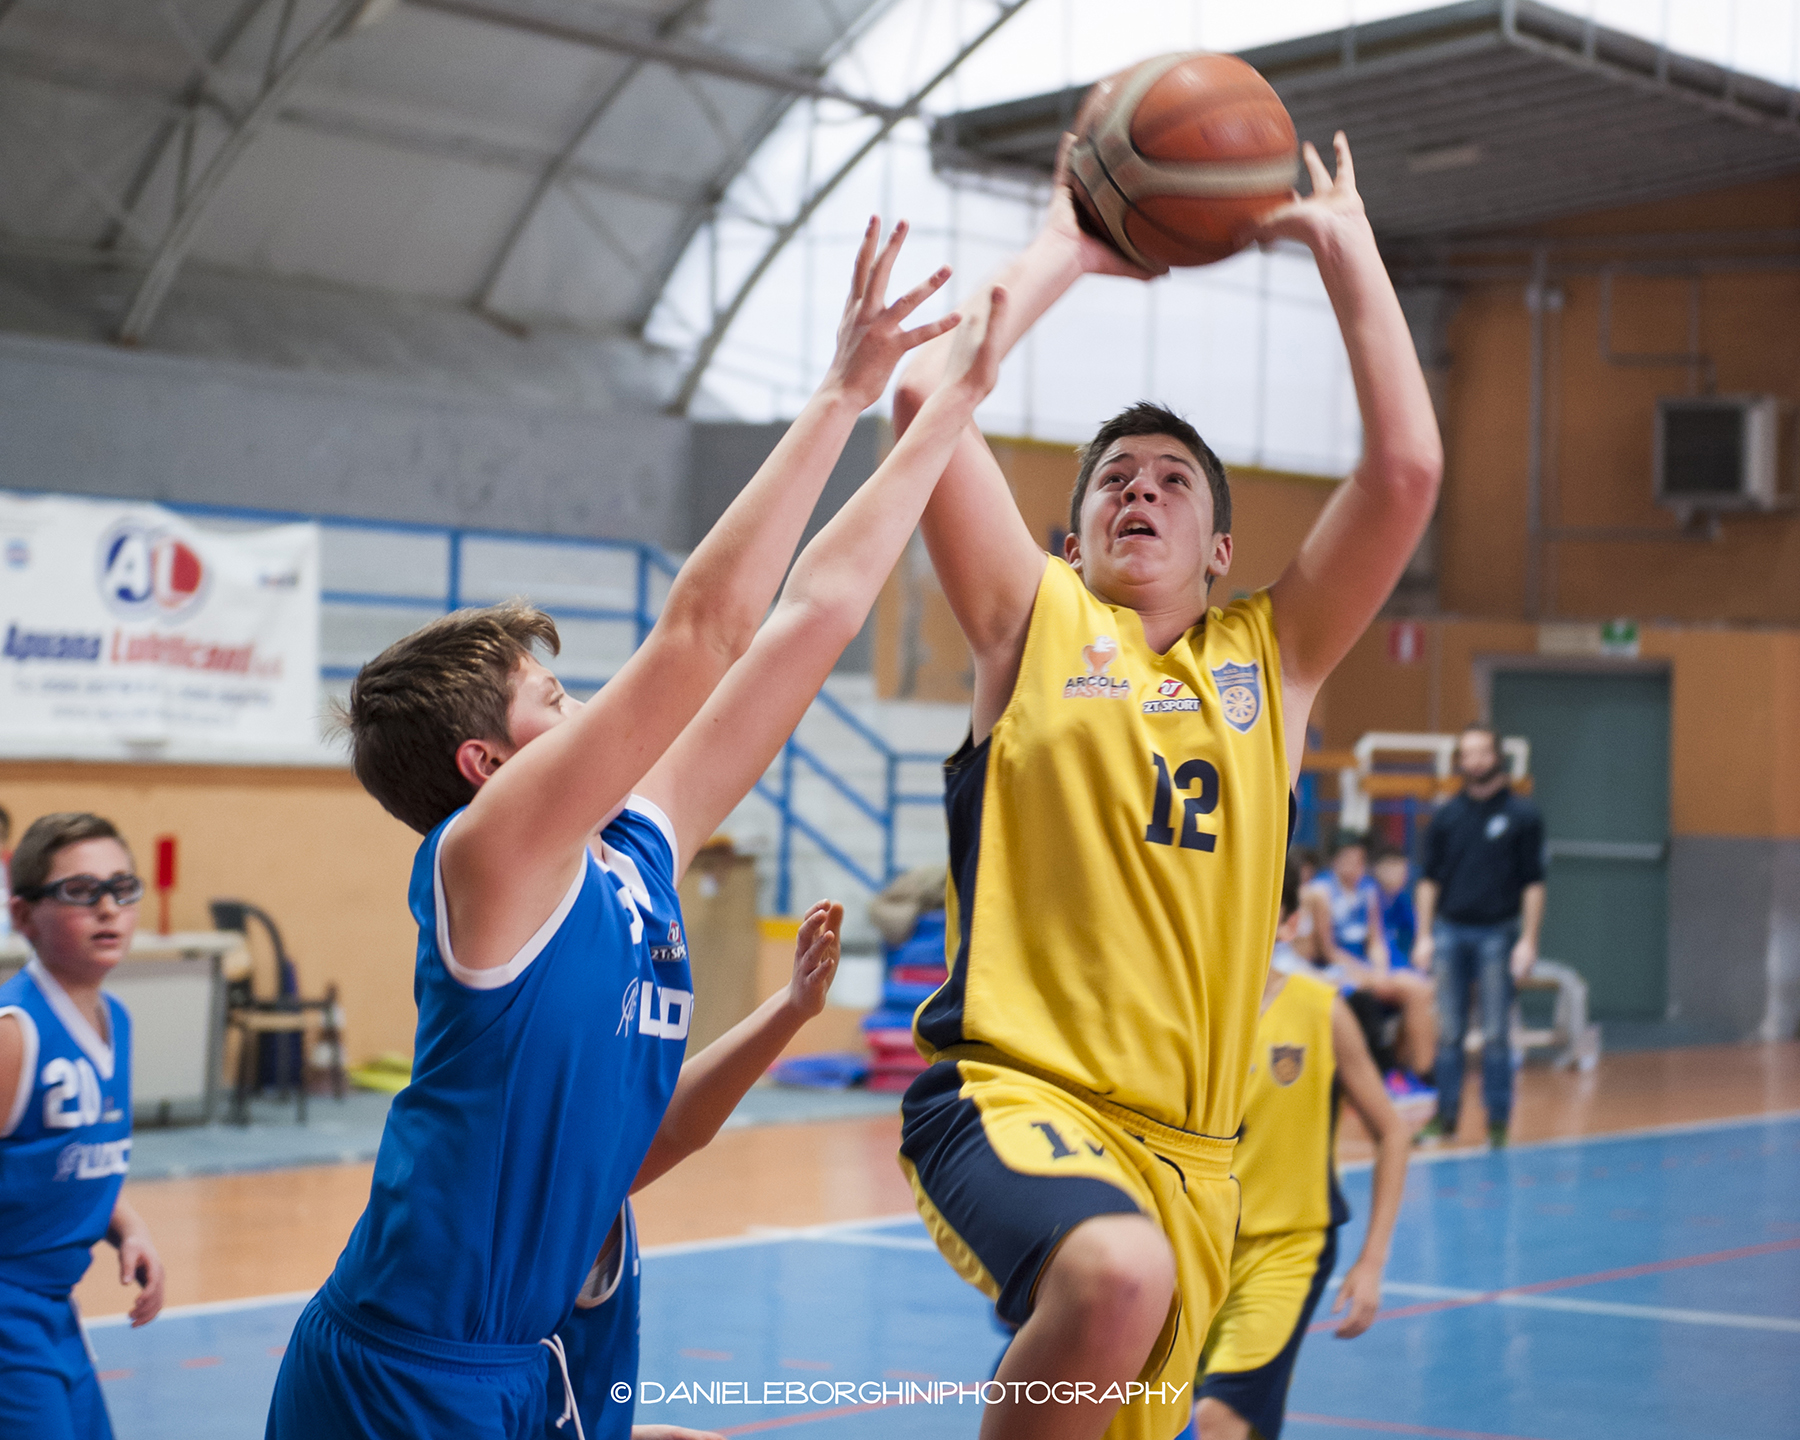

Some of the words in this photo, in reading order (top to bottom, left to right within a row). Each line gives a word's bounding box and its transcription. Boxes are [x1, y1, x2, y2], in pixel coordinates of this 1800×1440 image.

[1065, 676, 1131, 689] ARCOLA
[1062, 685, 1132, 700] BASKET
[1161, 699, 1201, 711] SPORT
[1145, 751, 1220, 853] 12
